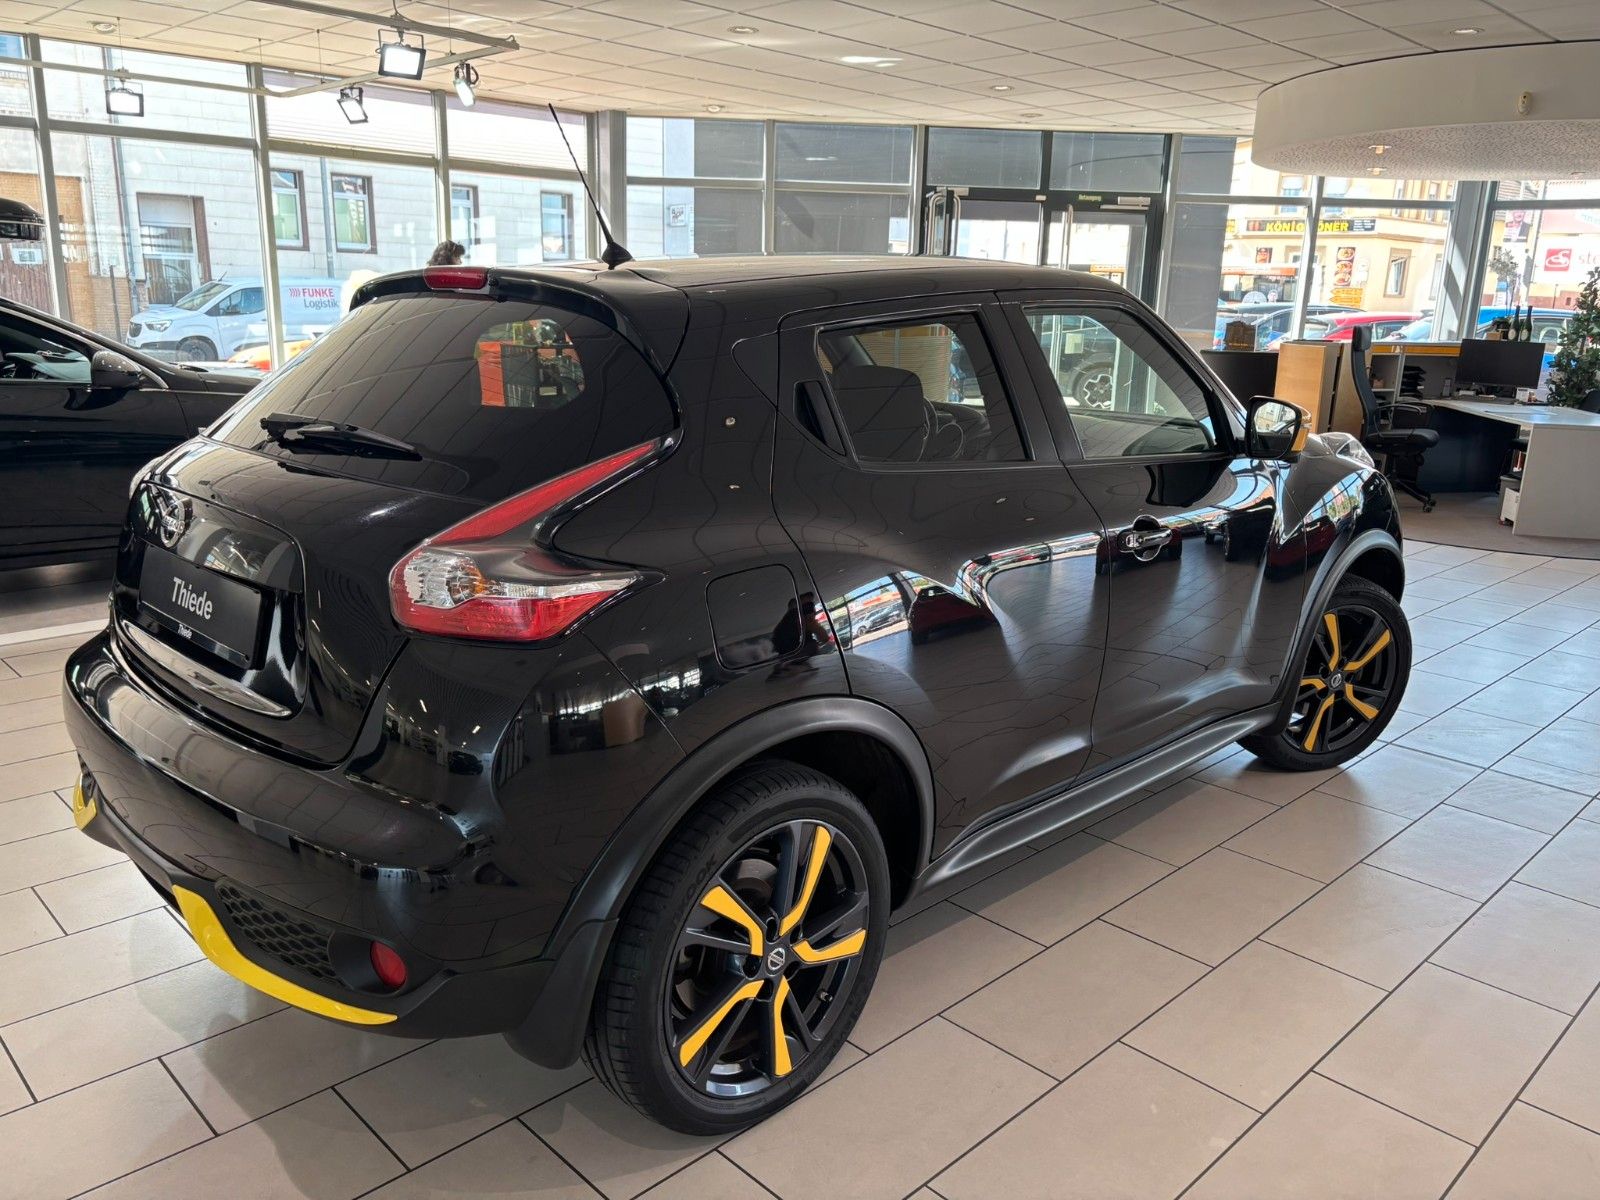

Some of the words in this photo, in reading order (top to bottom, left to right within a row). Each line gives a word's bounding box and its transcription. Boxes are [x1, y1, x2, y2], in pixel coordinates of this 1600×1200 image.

[1318, 220, 1349, 233] ÖNER
[302, 288, 334, 297] FUNKE
[303, 298, 340, 310] Logistik
[172, 576, 213, 620] Thiede
[177, 624, 193, 639] Thiede
